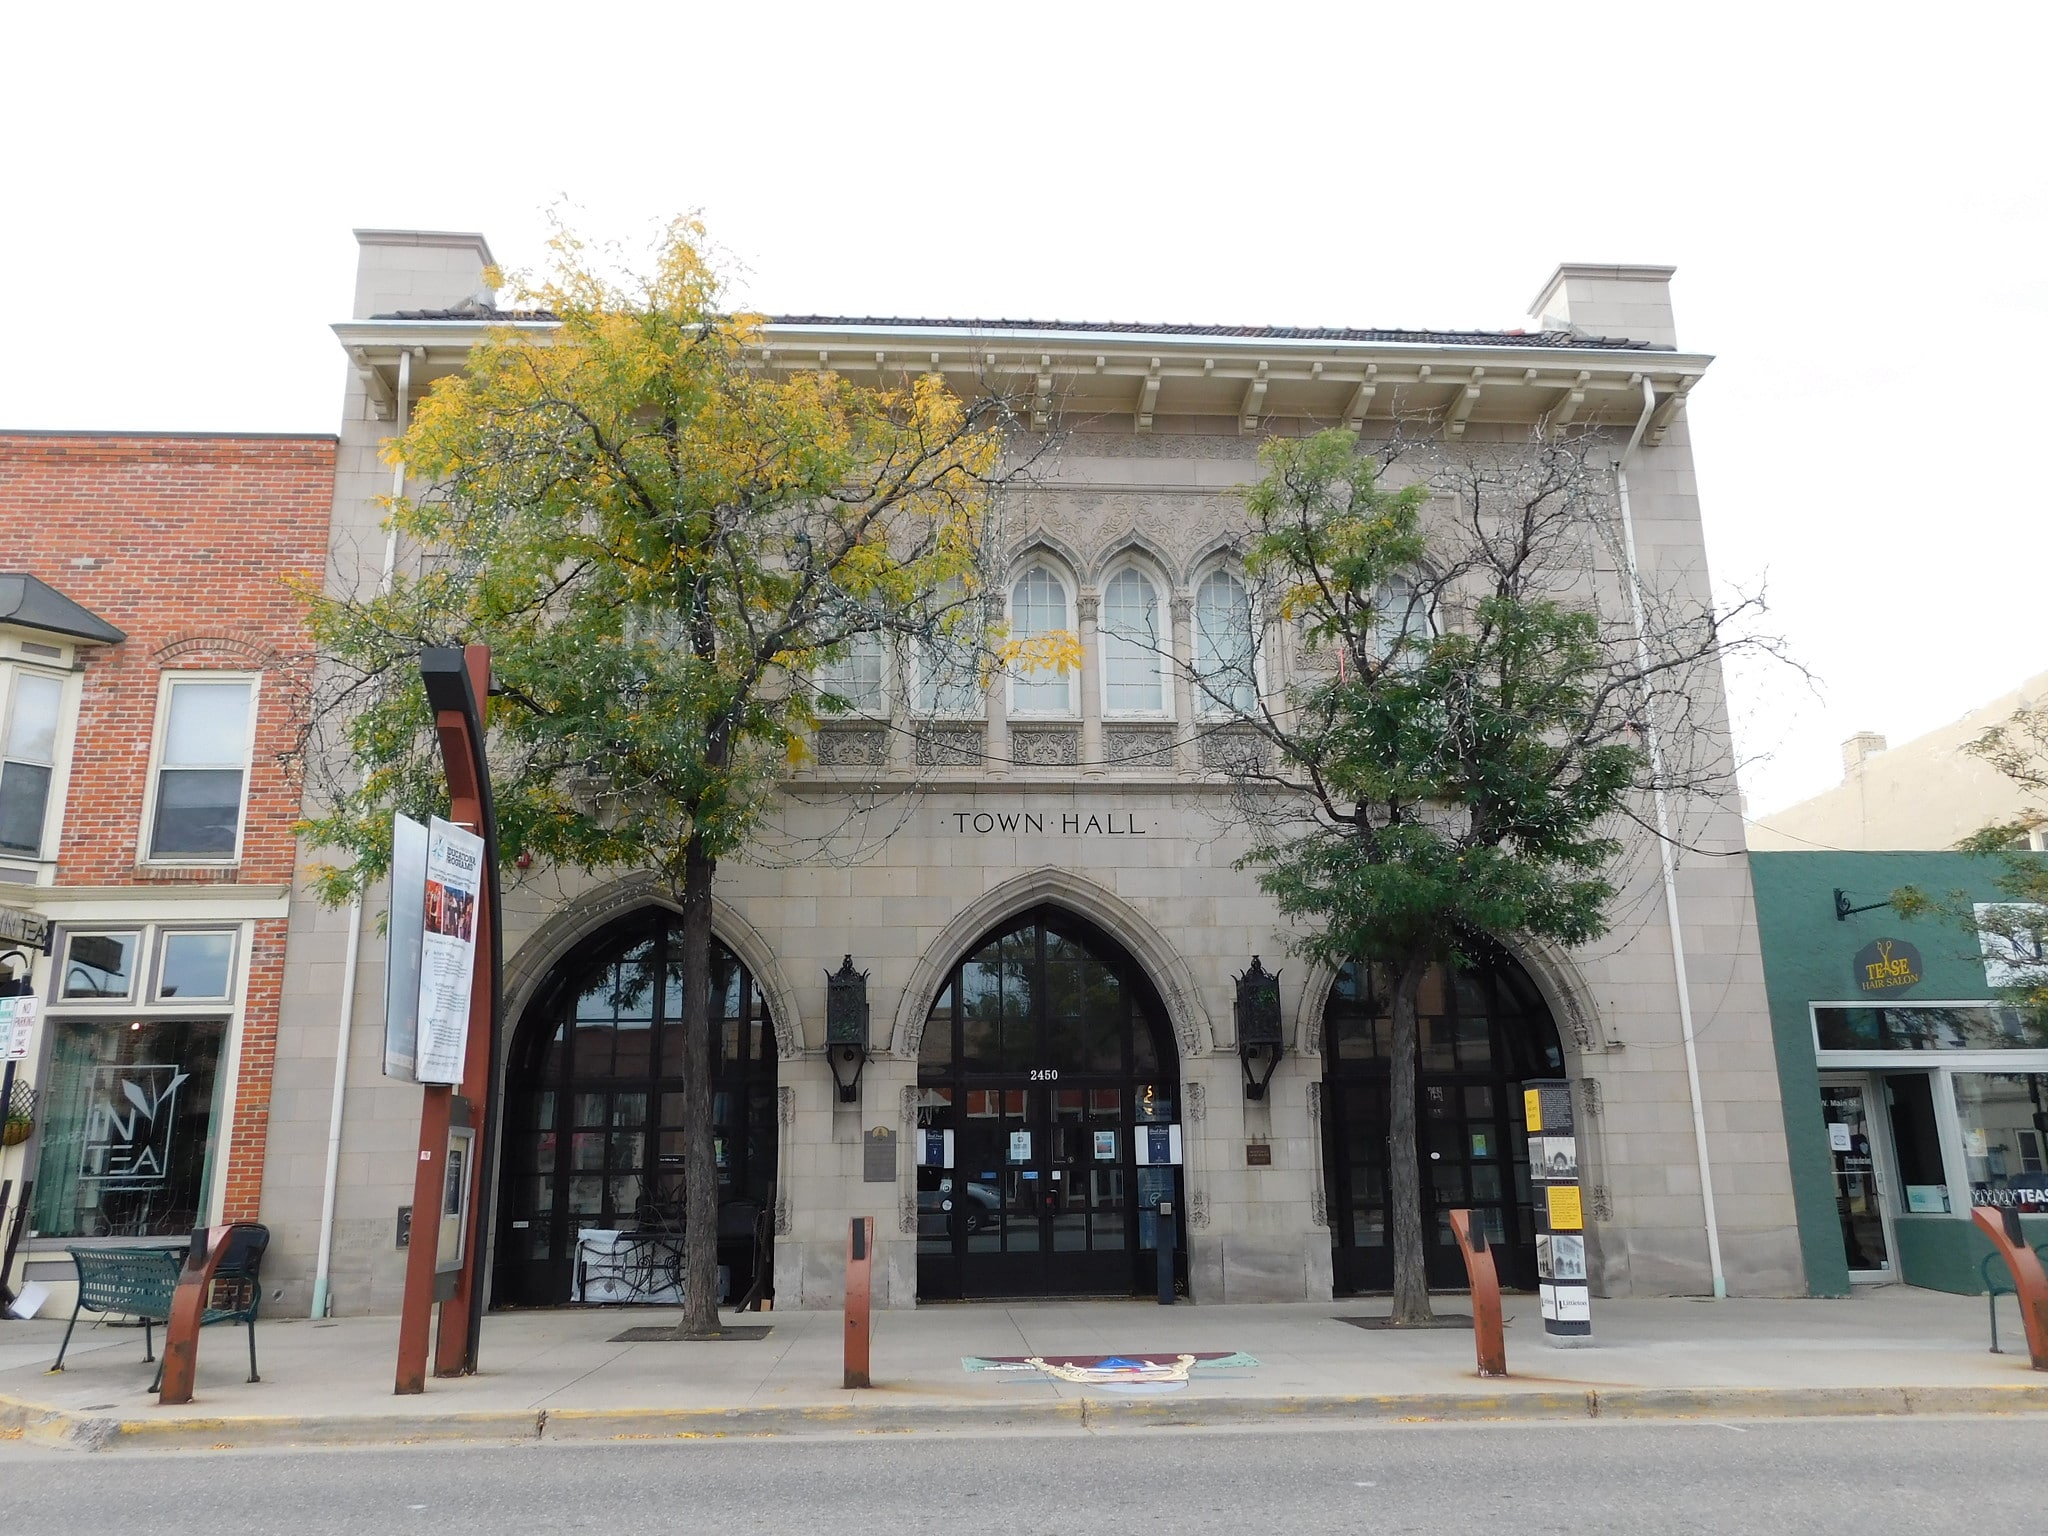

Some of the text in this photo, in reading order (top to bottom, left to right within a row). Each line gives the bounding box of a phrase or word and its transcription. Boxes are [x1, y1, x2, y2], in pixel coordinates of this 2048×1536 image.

[953, 813, 1147, 834] TOWN HALL
[21, 918, 45, 944] TEA
[1865, 957, 1910, 980] TEASE
[1862, 974, 1919, 991] HAIR SALON
[23, 1002, 32, 1013] NO
[1030, 1069, 1058, 1081] 2450
[1830, 1099, 1848, 1107] Main
[91, 1101, 137, 1141] IN
[87, 1144, 161, 1175] TEA
